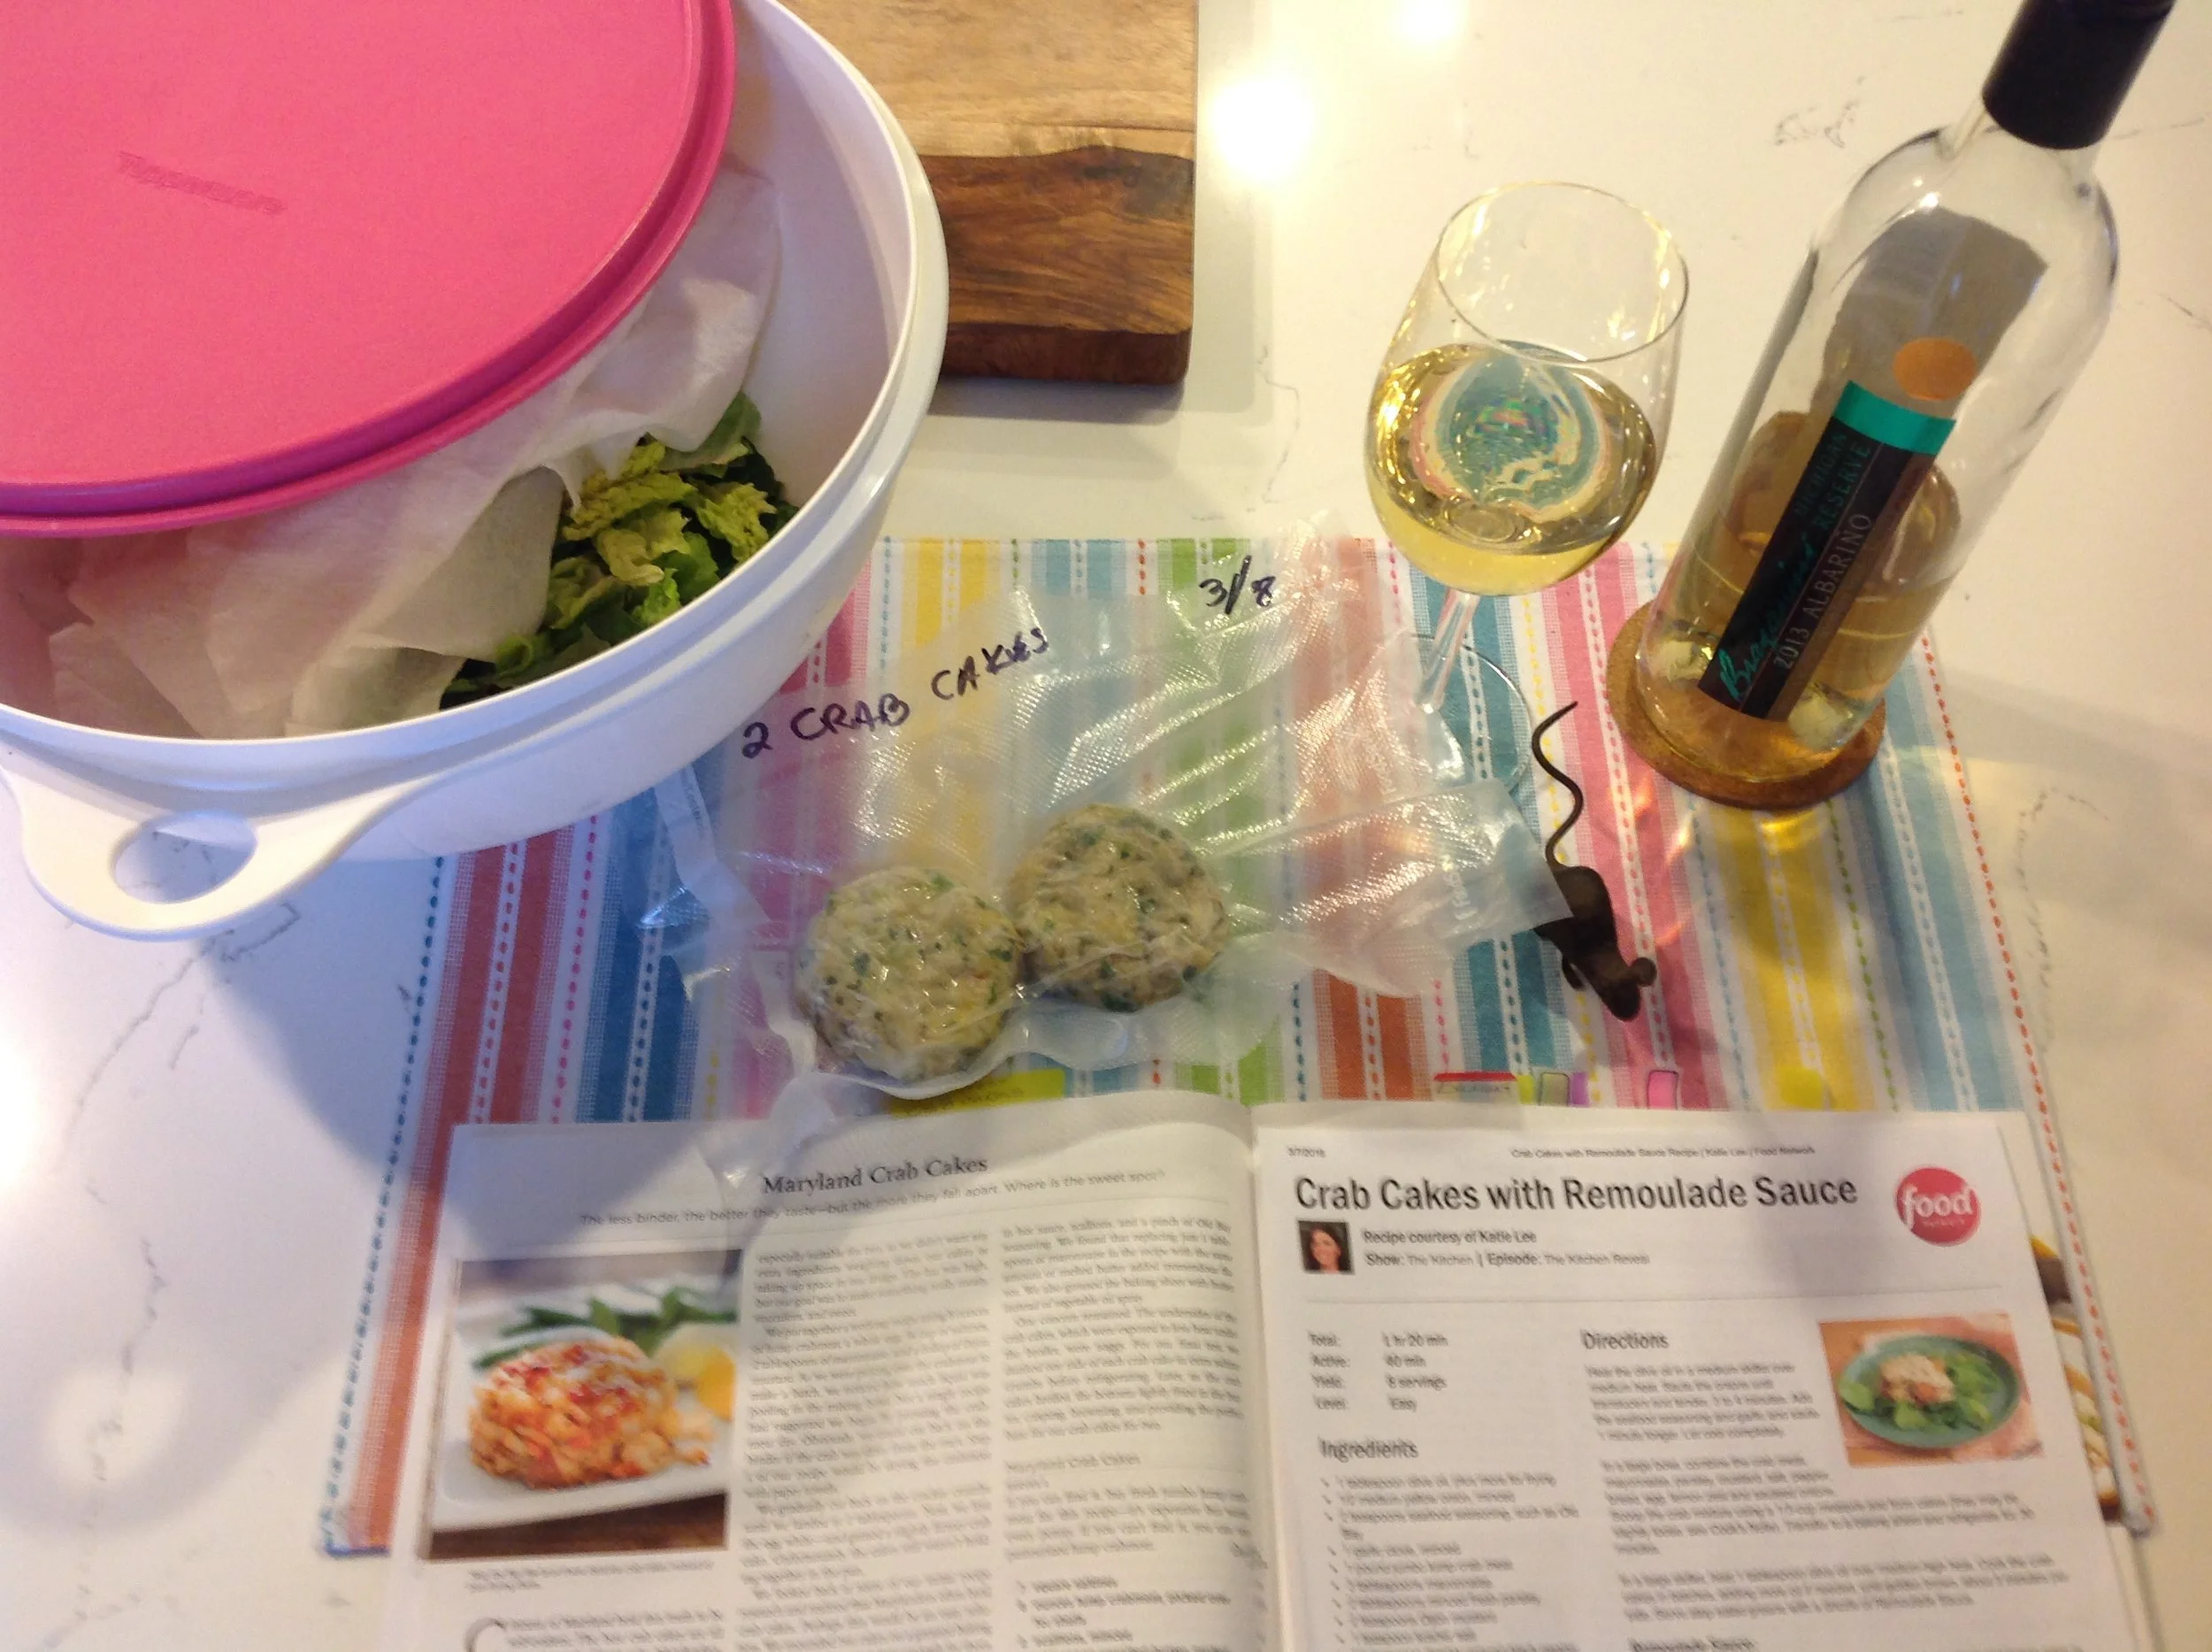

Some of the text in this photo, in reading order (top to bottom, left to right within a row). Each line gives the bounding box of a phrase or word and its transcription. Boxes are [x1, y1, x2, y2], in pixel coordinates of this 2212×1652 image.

[1811, 442, 1872, 531] RESERVE
[1199, 555, 1276, 615] 3/8
[1773, 626, 1810, 671] 2013
[741, 626, 1050, 758] 2 CRAB CAKES
[762, 1154, 989, 1196] Maryland Crab Cakes
[1294, 1175, 1858, 1210] Crab Cakes with Remoulade Sauce
[609, 1213, 633, 1226] less
[636, 1211, 680, 1225] binder,
[684, 1209, 705, 1222] the
[710, 1209, 749, 1221] better
[753, 1206, 780, 1221] they
[852, 1199, 872, 1212] the
[1003, 1179, 1047, 1195] Where
[1050, 1178, 1062, 1190] is
[1064, 1175, 1085, 1187] the
[1088, 1172, 1126, 1186] sweet
[1902, 1182, 1974, 1230] food
[1361, 1228, 1538, 1246] Recipe courtesy of Katie Lee
[1364, 1250, 1405, 1266] Show:
[1407, 1252, 1428, 1266] The
[1431, 1251, 1474, 1266] Kitchen
[1486, 1250, 1541, 1267] Episode:
[1544, 1253, 1565, 1266] The
[1567, 1252, 1610, 1266] Kitchen
[1613, 1251, 1650, 1265] Reveal
[1581, 1329, 1671, 1350] Directions
[1398, 1374, 1447, 1391] servings
[1317, 1436, 1419, 1464] Ingredients
